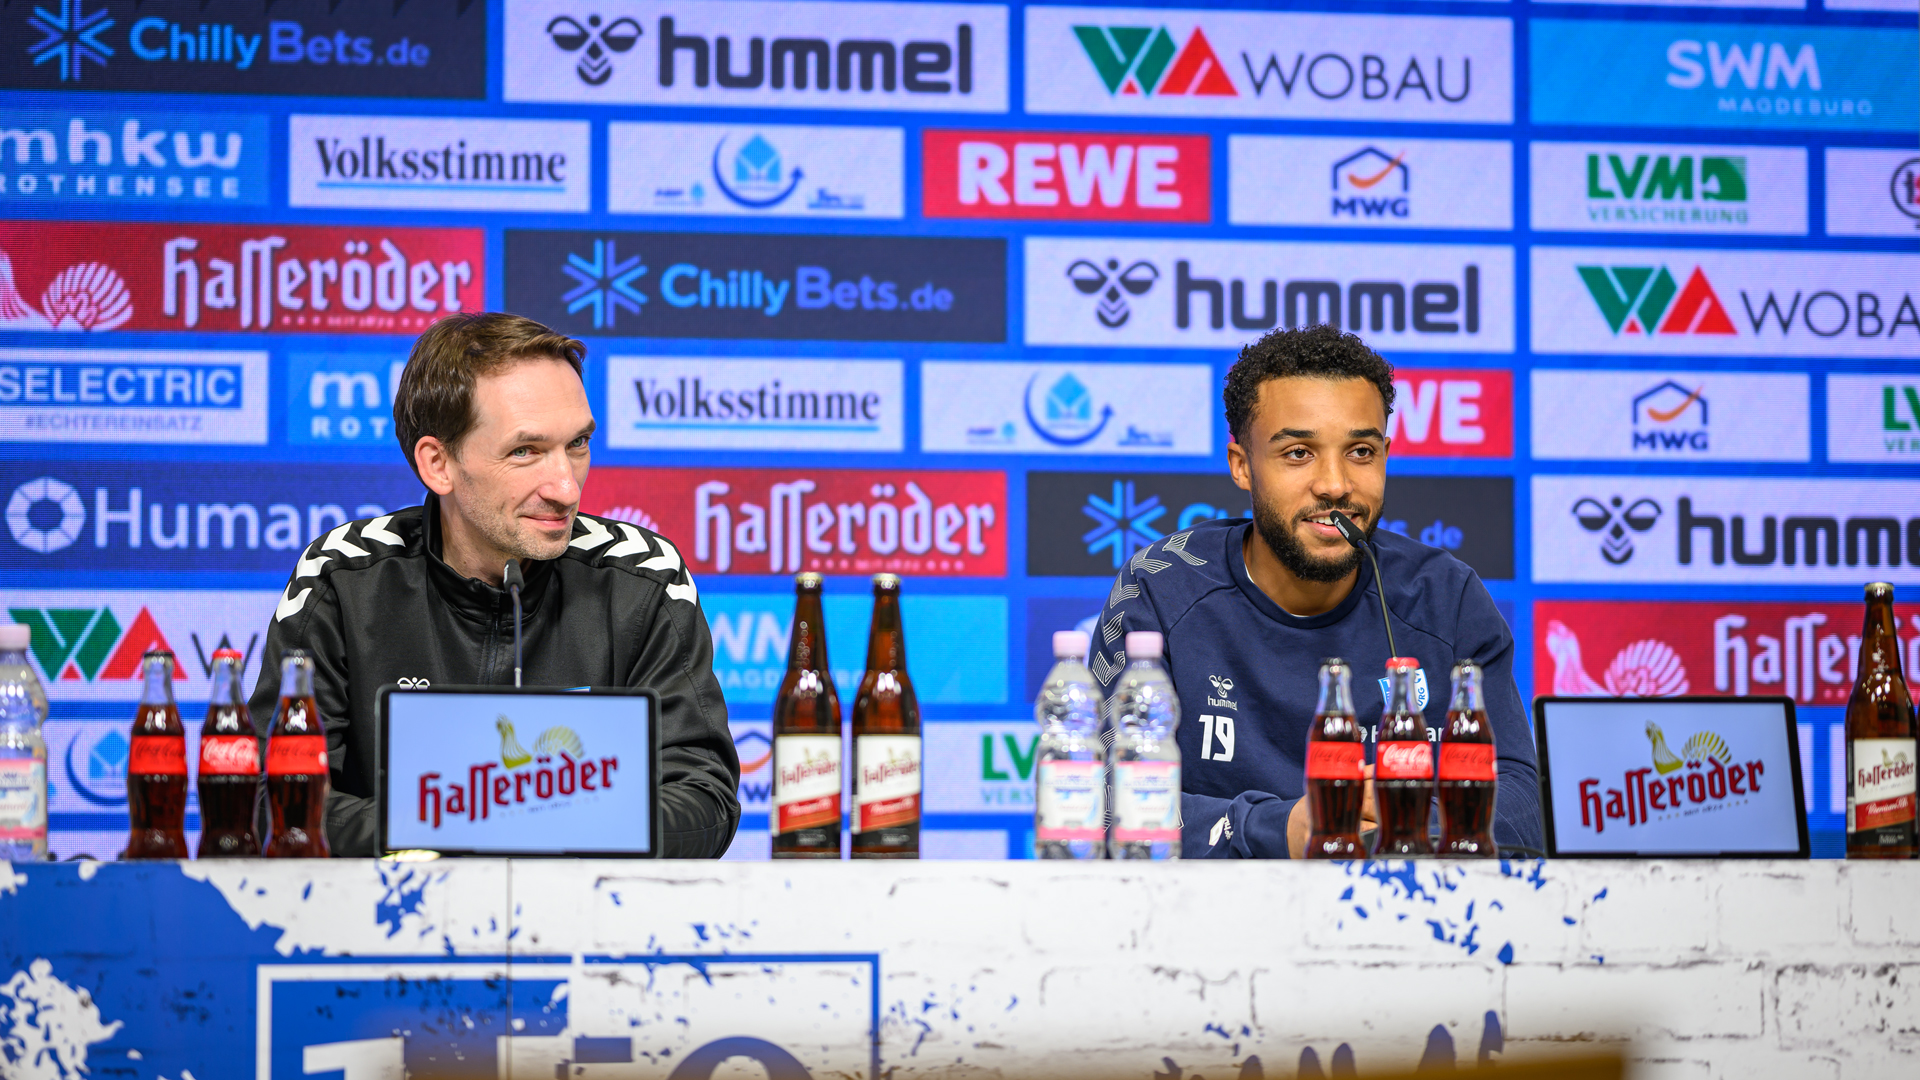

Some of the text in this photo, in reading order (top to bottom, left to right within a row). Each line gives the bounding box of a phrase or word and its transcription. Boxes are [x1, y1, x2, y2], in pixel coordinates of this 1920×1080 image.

[658, 15, 973, 94] hummel
[1241, 51, 1471, 102] WOBAU
[1666, 39, 1822, 90] SWM
[1718, 97, 1873, 117] MAGDEBURG
[0, 117, 242, 168] mhkw
[316, 136, 567, 184] Volksstimme
[958, 141, 1182, 208] REWE
[1587, 153, 1693, 200] LVM
[1332, 197, 1409, 218] MWG
[1589, 205, 1748, 225] VERSICHERUNG
[1175, 259, 1480, 334] hummel
[0, 367, 236, 403] SELECTRIC
[634, 377, 880, 422] Volksstimme
[1632, 431, 1709, 451] MWG
[1677, 495, 1920, 568] humm
[1207, 695, 1238, 711] hummel
[1198, 714, 1235, 762] 19
